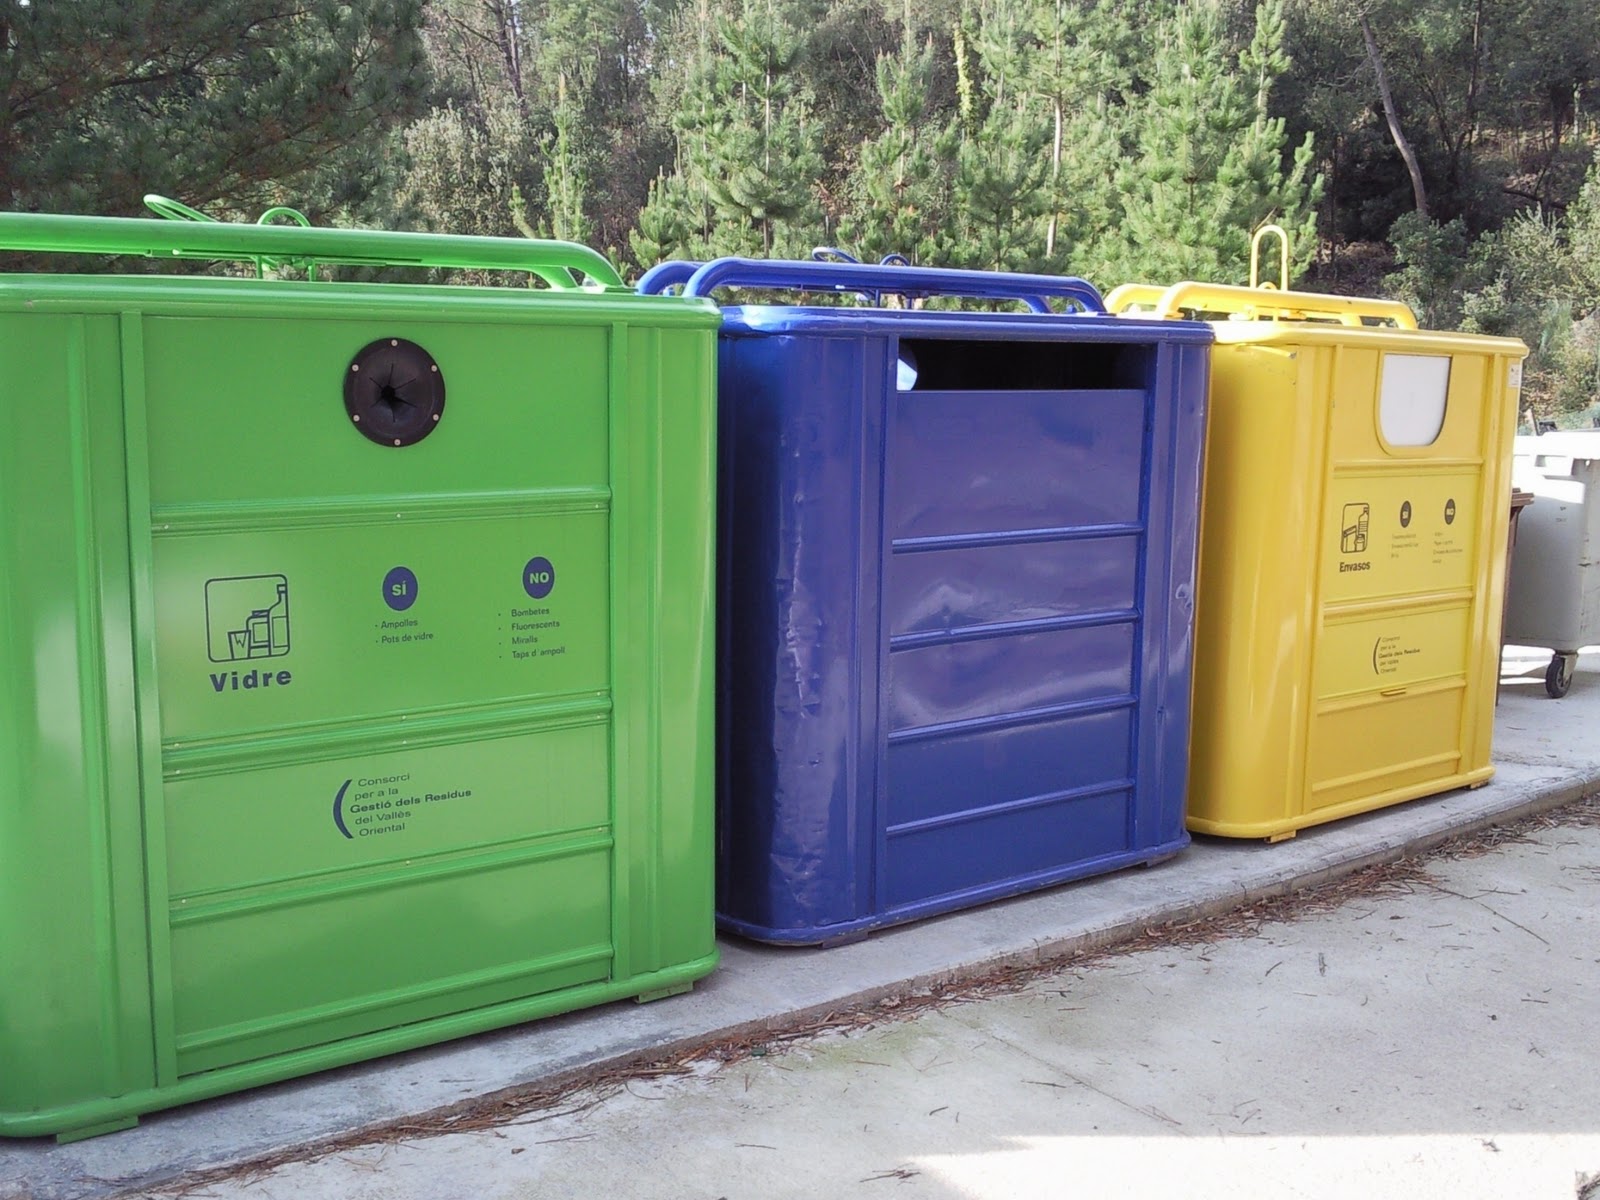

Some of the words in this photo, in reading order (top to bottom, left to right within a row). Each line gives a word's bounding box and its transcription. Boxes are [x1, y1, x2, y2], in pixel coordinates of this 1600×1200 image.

[1340, 561, 1370, 572] Envasos
[529, 572, 550, 584] NO
[392, 580, 407, 596] SÍ
[511, 608, 550, 618] Bombetes
[381, 618, 418, 630] Ampolles
[511, 620, 560, 630] Fluorescents
[382, 635, 400, 644] Pots
[402, 634, 412, 642] de
[414, 632, 434, 640] vidre
[512, 635, 538, 645] Miralls
[512, 650, 530, 660] Taps
[210, 670, 292, 692] Vidre
[358, 773, 410, 787] Consorci
[354, 791, 374, 802] per
[388, 788, 398, 796] la
[350, 801, 392, 814] Gestió
[395, 796, 421, 807] dels
[424, 789, 472, 802] Residus
[354, 814, 373, 825] del
[376, 810, 412, 822] Vallès
[359, 822, 406, 836] Oriental
